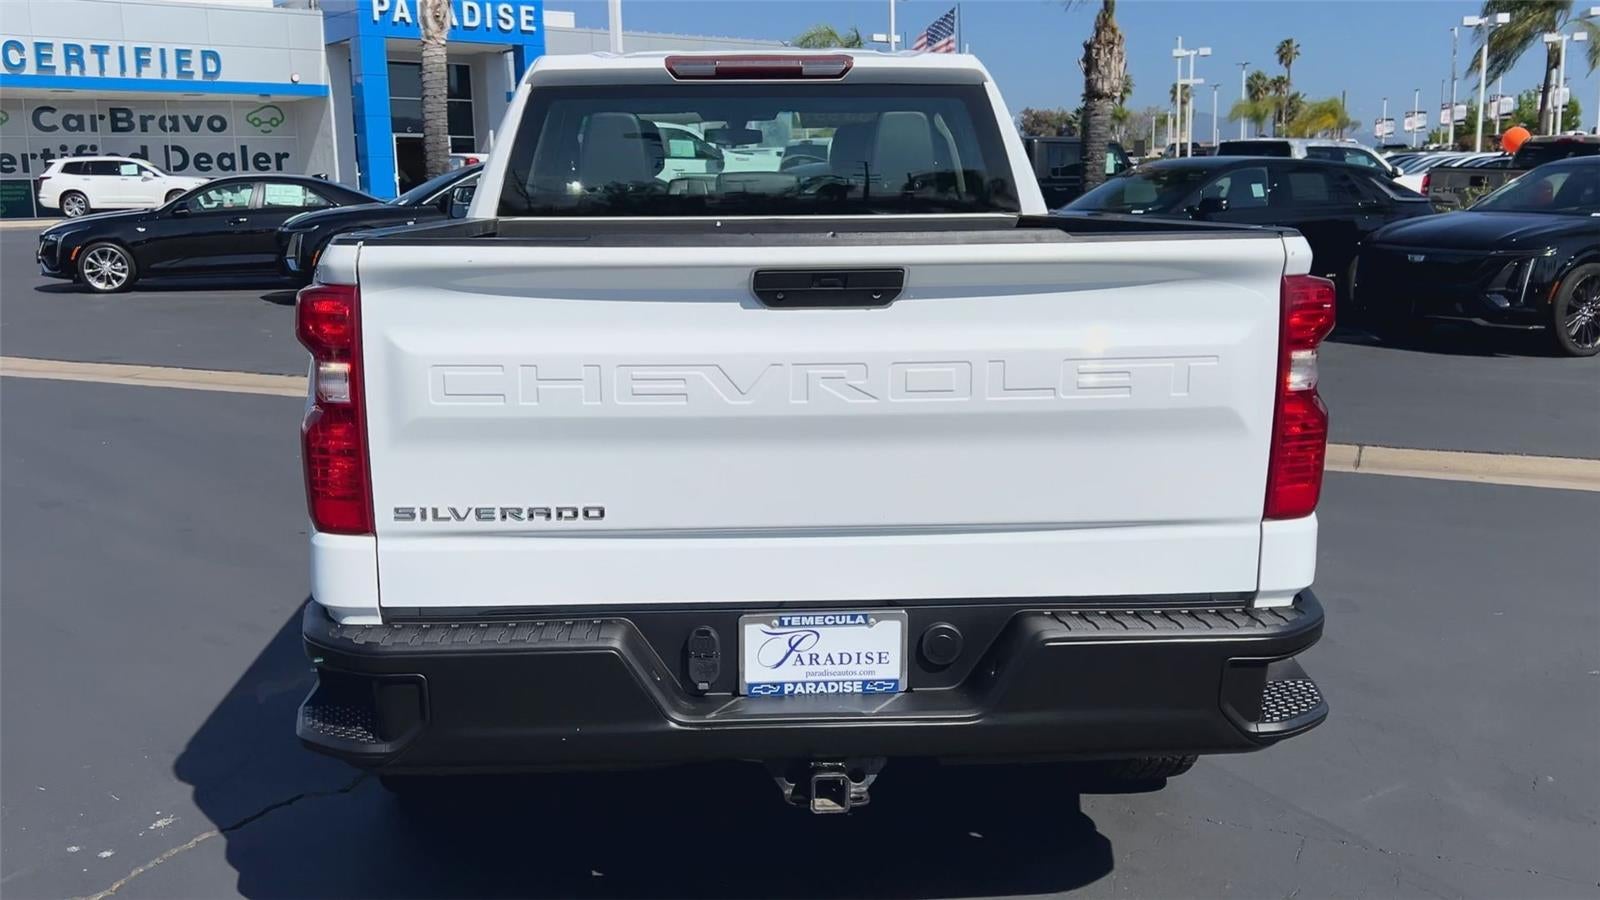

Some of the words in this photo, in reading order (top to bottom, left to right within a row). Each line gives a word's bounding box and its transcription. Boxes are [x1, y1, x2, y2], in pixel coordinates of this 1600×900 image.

[372, 0, 537, 32] PADISE
[1, 39, 222, 81] CERTIFIED
[31, 105, 228, 135] CarBravo
[163, 144, 290, 173] Dealer
[428, 355, 1219, 405] CHEVROLET
[393, 505, 606, 522] SILVERADO
[781, 615, 866, 626] TEMECULA
[757, 629, 890, 669] PARADISE
[784, 681, 863, 694] PARADISE
[805, 668, 876, 678] paradiseautos.com
